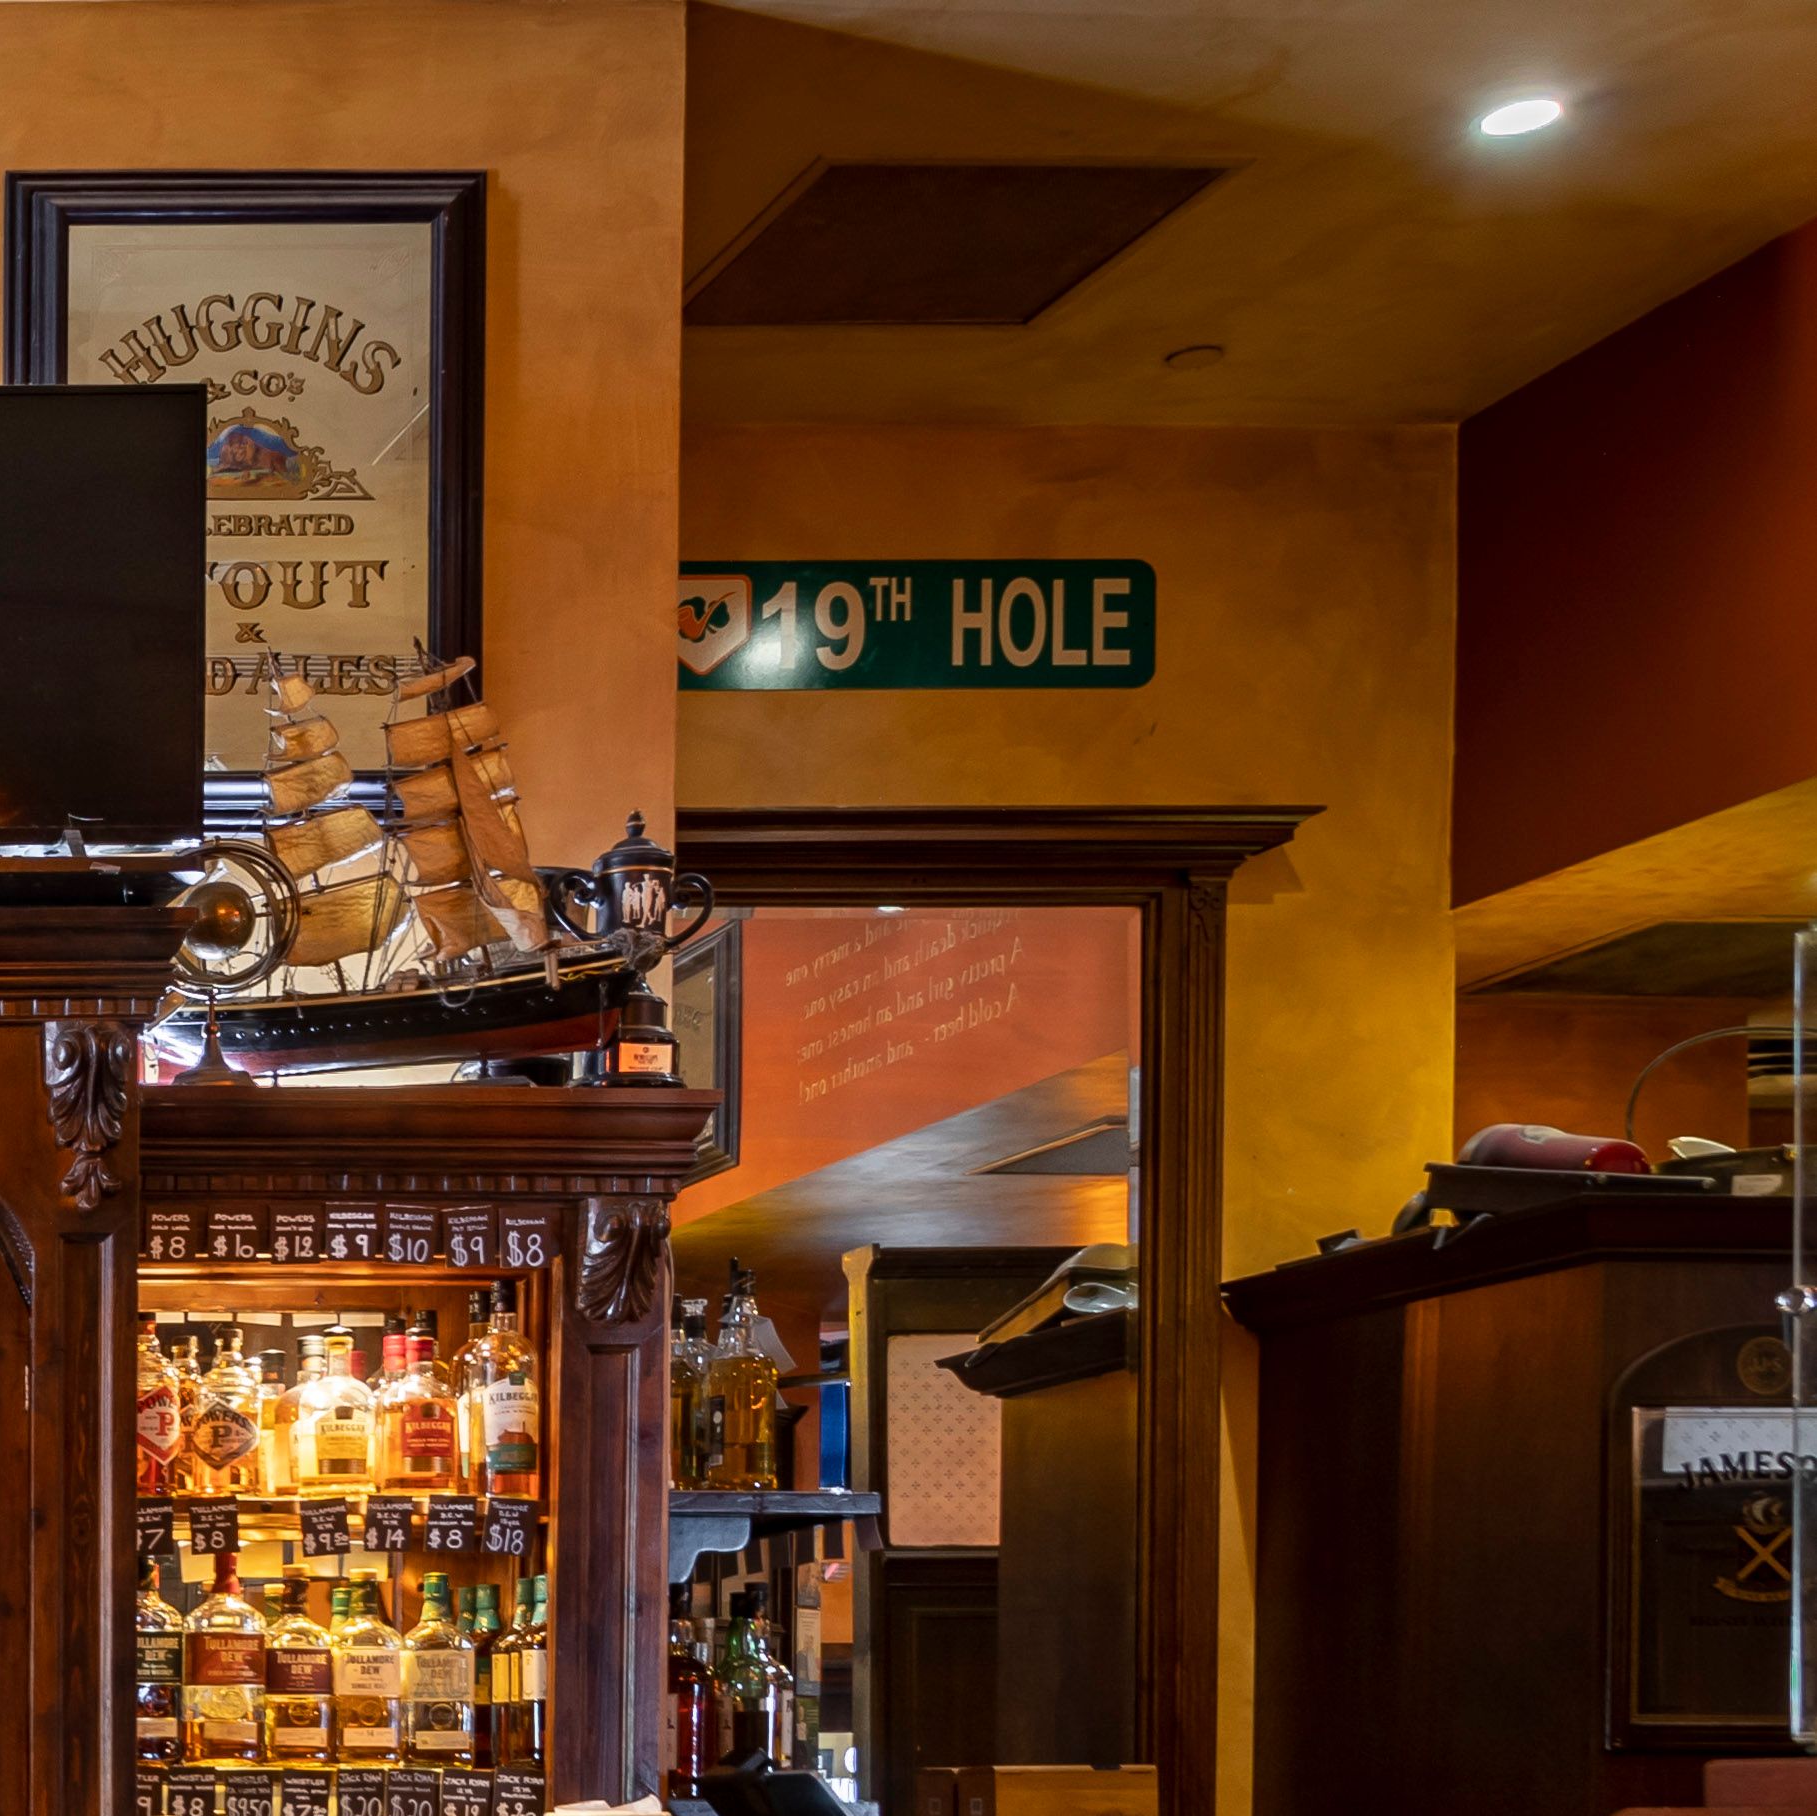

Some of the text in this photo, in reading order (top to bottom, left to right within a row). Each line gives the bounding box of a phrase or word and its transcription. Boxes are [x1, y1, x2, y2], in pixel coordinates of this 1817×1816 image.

[99, 292, 402, 395] HUGGINS
[206, 514, 354, 536] EBRATED
[235, 622, 267, 643] &
[762, 575, 1131, 671] 19TH HOLE
[151, 1213, 190, 1223] POWERS
[214, 1213, 253, 1222] POWERS
[276, 1214, 316, 1223] POWERS
[150, 1235, 186, 1260] $8
[331, 1234, 369, 1258] $9
[387, 1234, 429, 1262] $10
[450, 1235, 484, 1267] $9
[508, 1232, 544, 1268] $8
[1678, 1450, 1817, 1492] JAMESO
[194, 1534, 226, 1551] $8
[367, 1529, 406, 1548] $14
[428, 1529, 463, 1549] $8
[487, 1525, 523, 1553] $18
[204, 1637, 260, 1651] TULLAMORE
[220, 1651, 244, 1664] DEW
[276, 1652, 328, 1664] TULLAMORE
[345, 1653, 395, 1665] TULLAMORE
[291, 1664, 313, 1675] DEW
[360, 1665, 380, 1676] DEW
